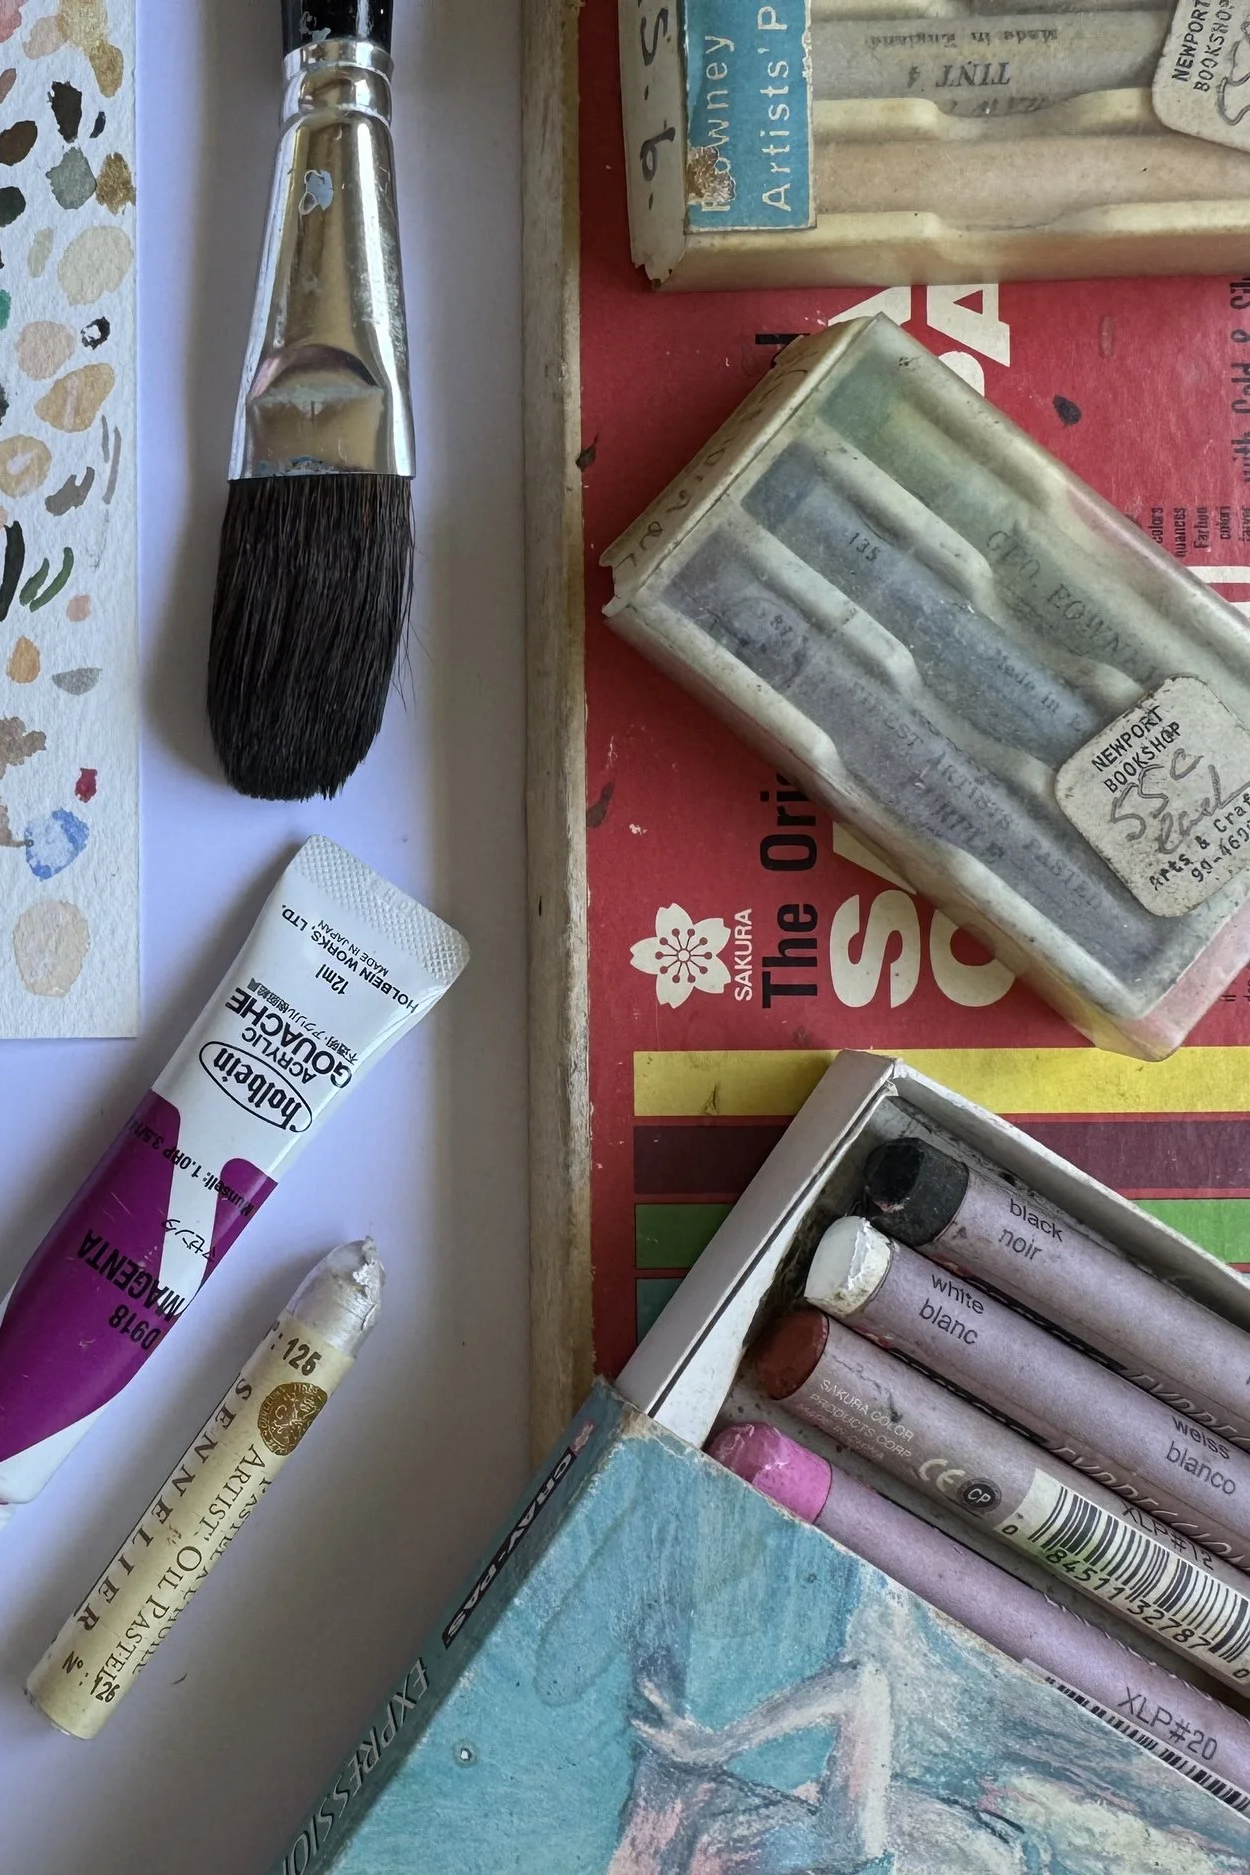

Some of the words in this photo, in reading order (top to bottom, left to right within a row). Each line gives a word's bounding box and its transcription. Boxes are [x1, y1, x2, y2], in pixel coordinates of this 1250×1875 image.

[935, 61, 1010, 88] TINT
[758, 47, 791, 212] Artists'
[1091, 704, 1164, 773] NEWPORT
[1103, 721, 1181, 794] BOOKSHOP
[1149, 852, 1194, 891] Arts
[281, 903, 309, 932] LTD.
[317, 919, 350, 945] JAPAN
[310, 925, 359, 972] WORKS,
[348, 942, 361, 956] IN
[359, 951, 390, 978] MADE
[734, 908, 752, 1002] SAKURA
[761, 902, 818, 1009] The
[314, 963, 350, 996] 12ml
[360, 967, 420, 1014] HOLBEIN
[224, 986, 353, 1089] GOUACHE
[241, 1025, 317, 1085] ACRYLIC
[213, 1047, 306, 1132] holbein
[1009, 1197, 1063, 1243] black
[998, 1227, 1043, 1263] noir
[75, 1228, 186, 1323] MAGENTA
[931, 1274, 985, 1315] white
[108, 1303, 162, 1351] D918
[918, 1296, 978, 1345] blanc
[809, 1393, 876, 1438] PRODUCTS
[820, 1378, 869, 1416] SAKURA
[1172, 1415, 1230, 1460] weiss
[1165, 1439, 1236, 1496] blanco
[76, 1376, 254, 1633] SENNELIER
[157, 1544, 203, 1592] OIL
[101, 1595, 172, 1682] PASTEL
[1117, 1686, 1218, 1761] XLP#20
